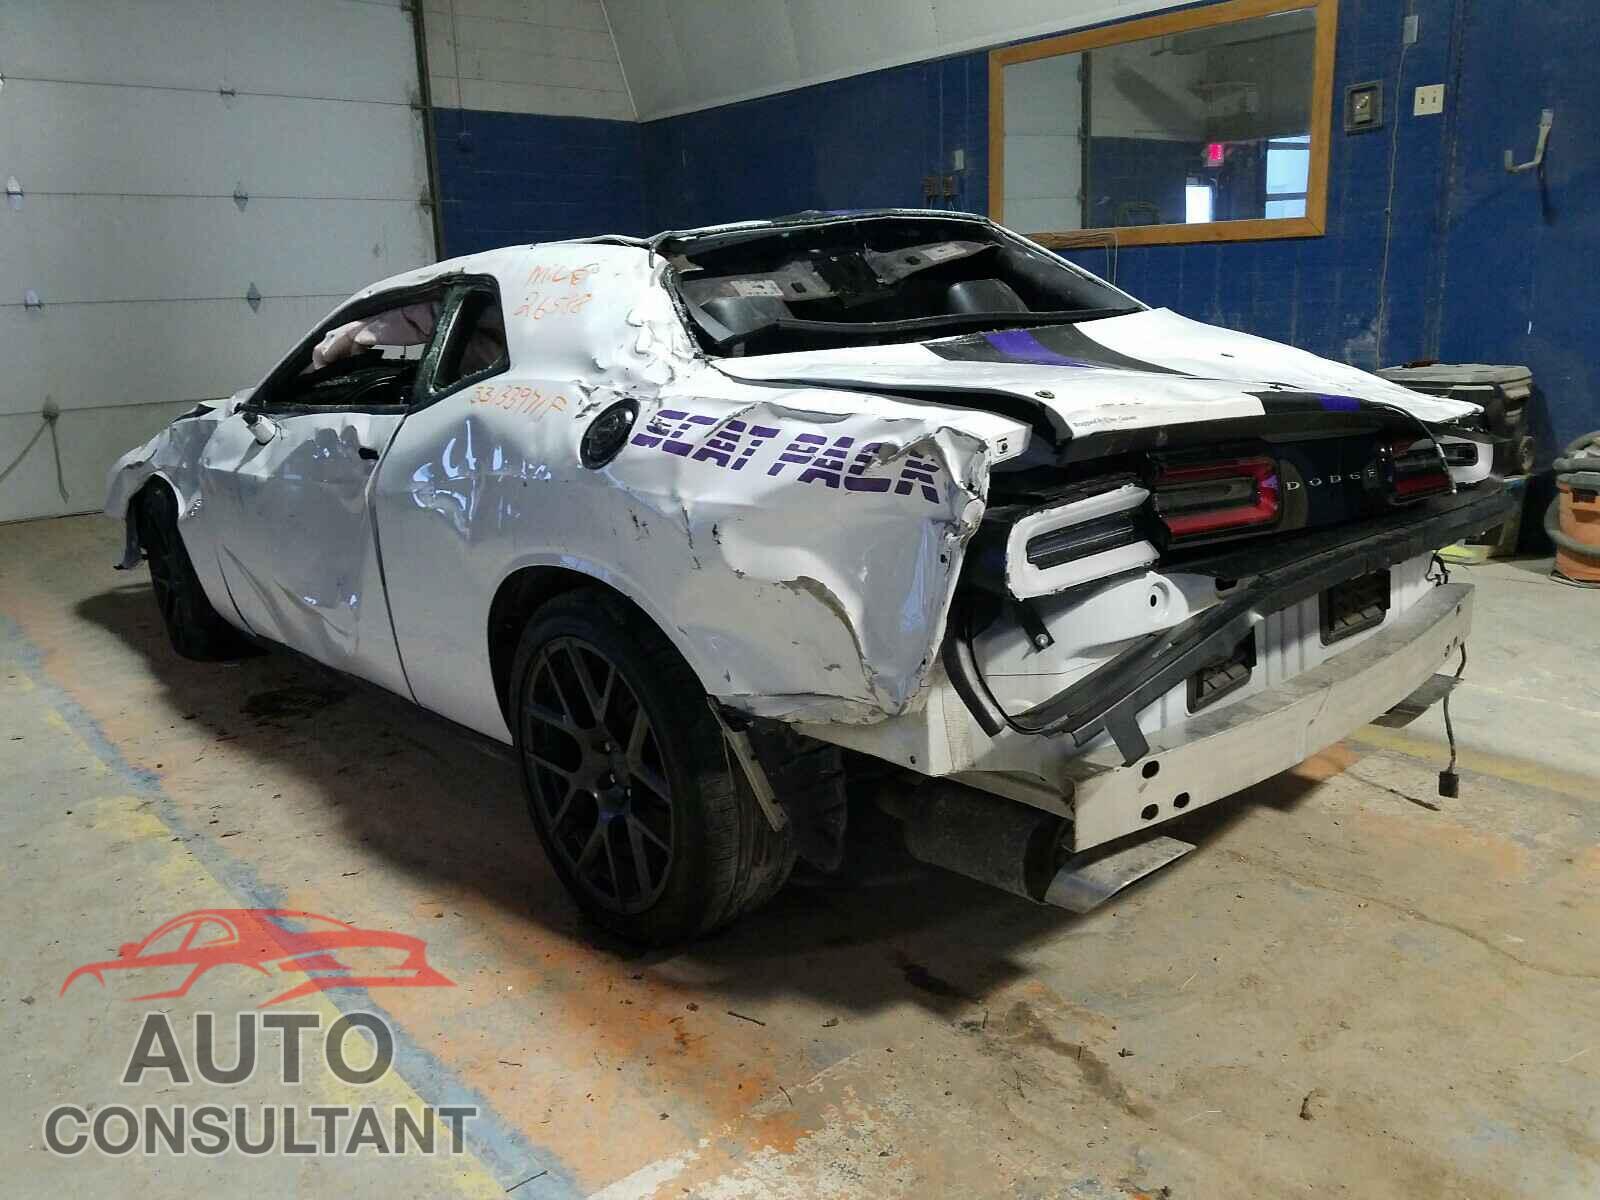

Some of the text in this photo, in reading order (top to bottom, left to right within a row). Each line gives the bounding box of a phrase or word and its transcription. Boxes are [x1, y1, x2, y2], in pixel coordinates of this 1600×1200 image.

[630, 408, 941, 505] SCAT PACK
[1286, 464, 1377, 491] DODGE
